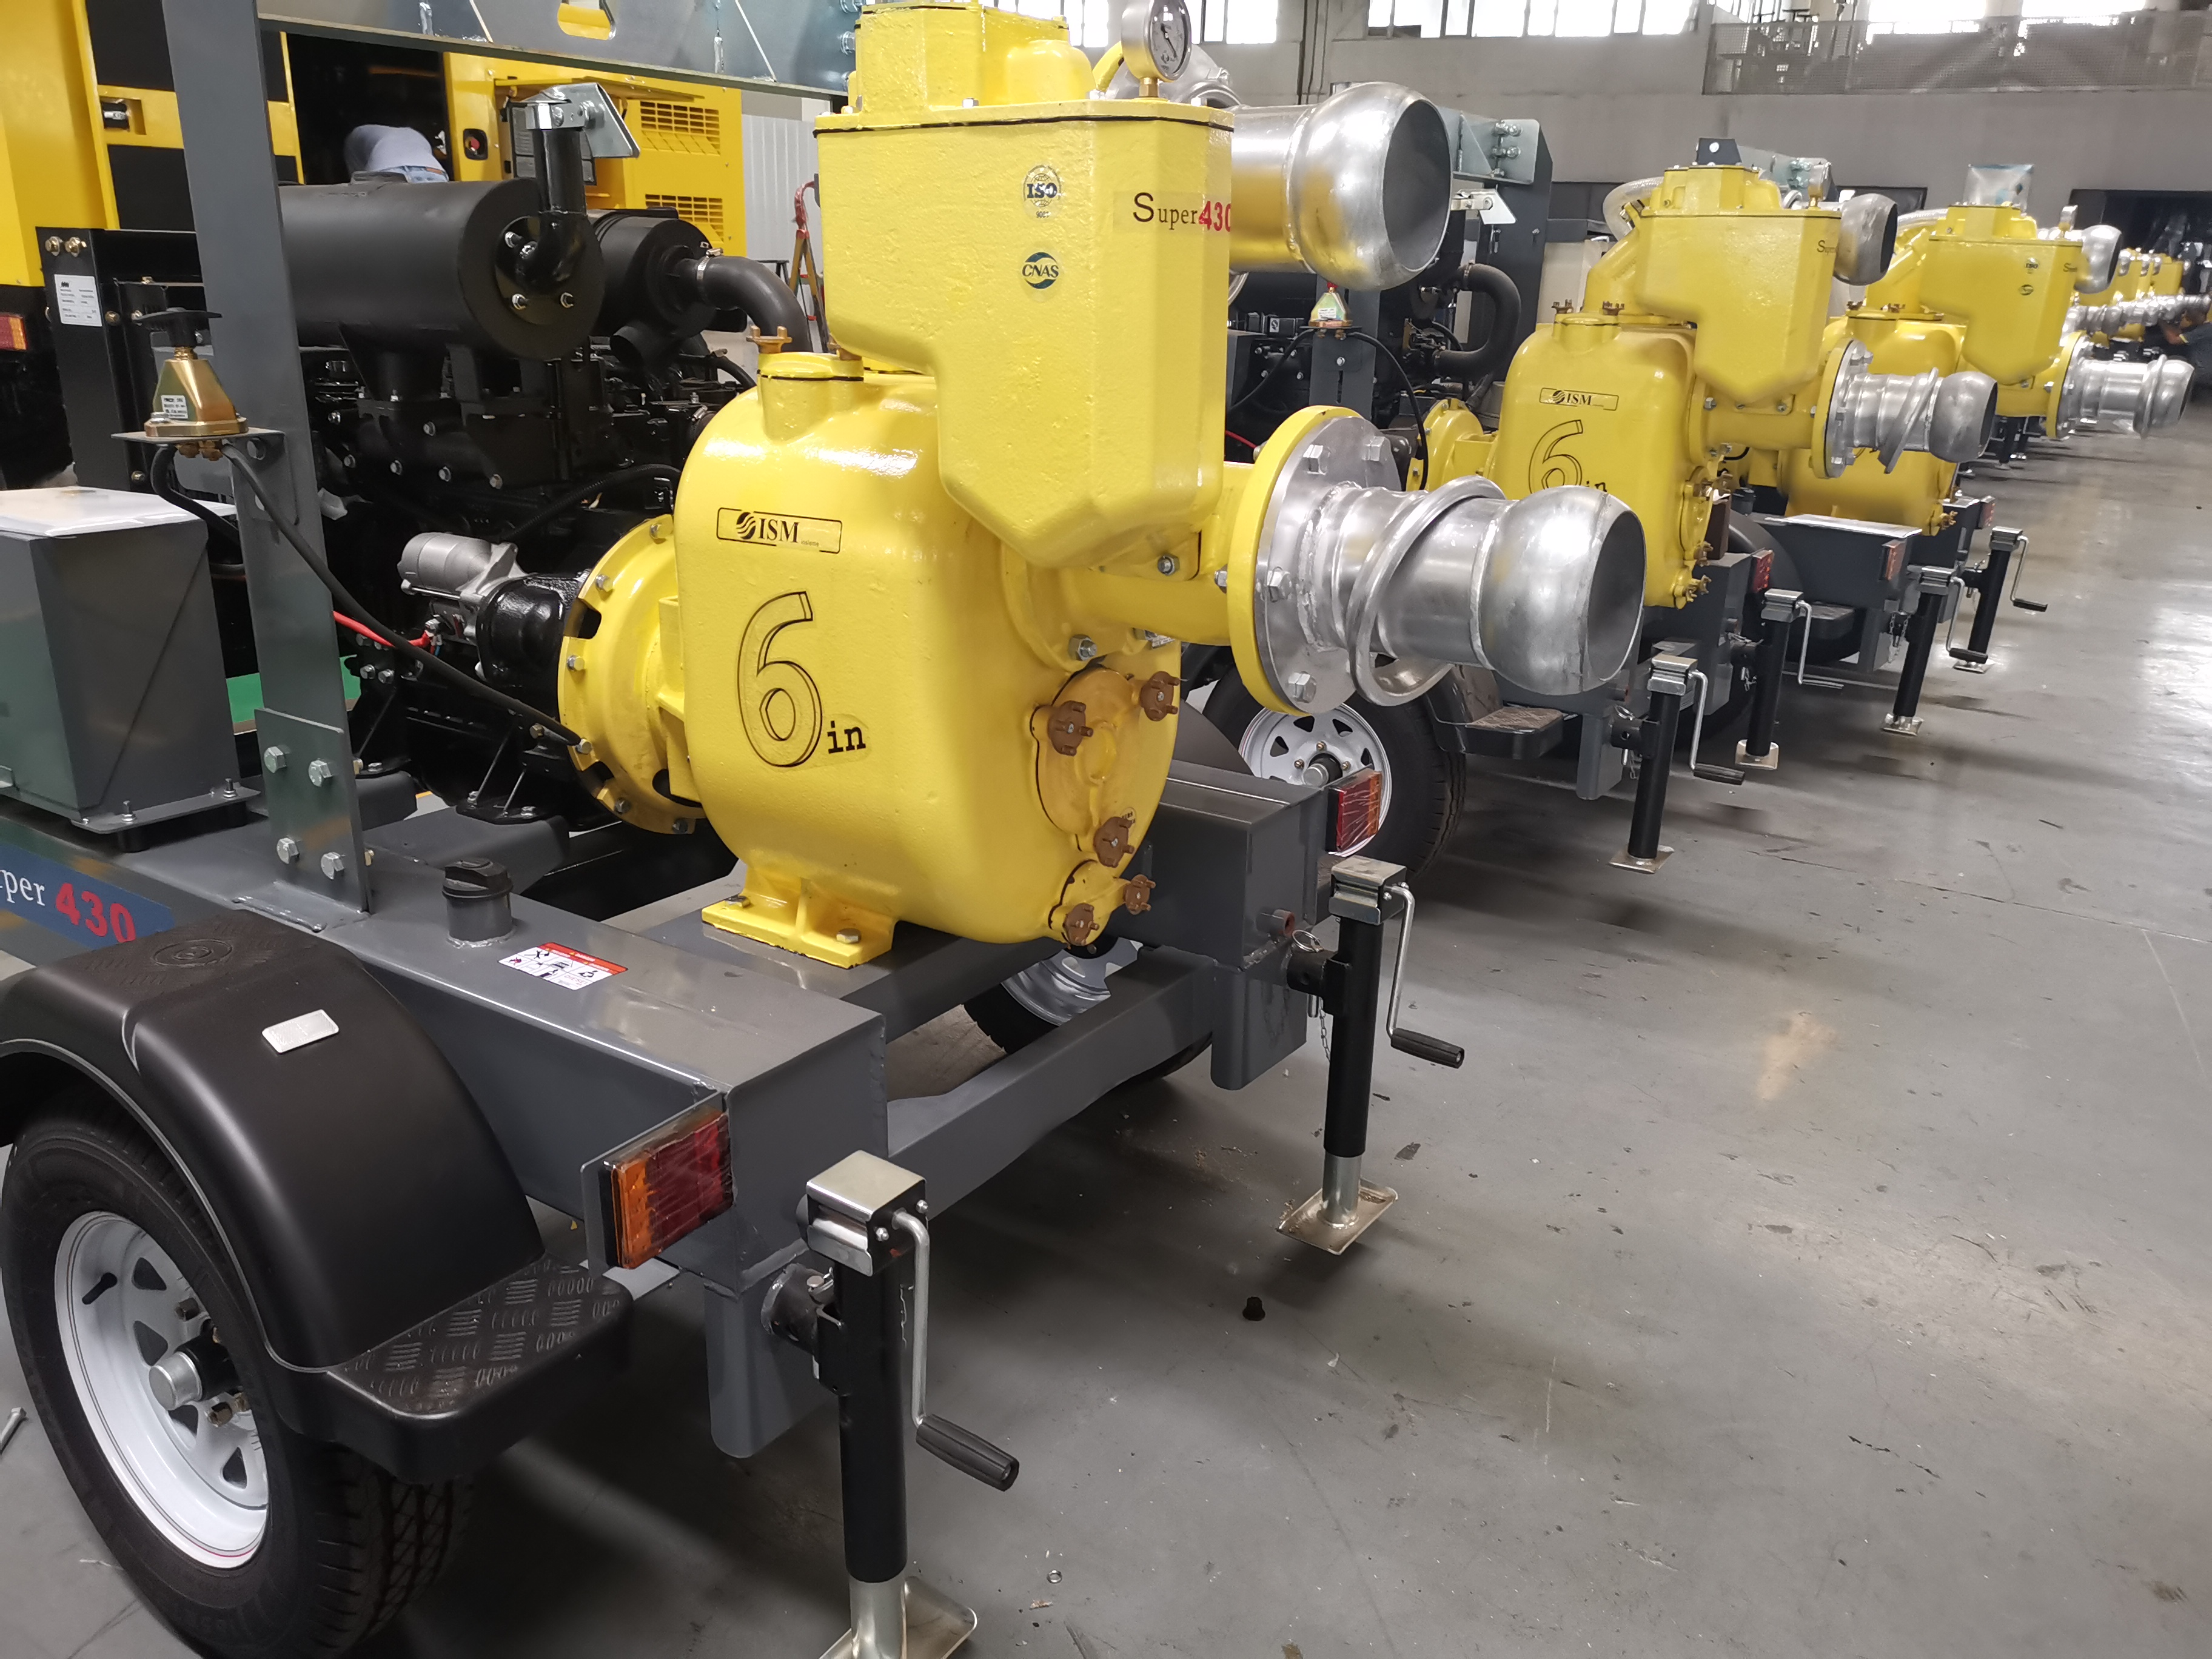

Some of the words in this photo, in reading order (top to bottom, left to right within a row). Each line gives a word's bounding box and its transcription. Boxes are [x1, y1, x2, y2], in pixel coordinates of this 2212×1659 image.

[1027, 183, 1057, 198] ISO
[1022, 264, 1059, 278] CNAS
[1566, 393, 1592, 405] ISM
[1528, 419, 1584, 494] 6
[757, 518, 800, 543] ISM
[737, 591, 823, 768] 6
[827, 720, 866, 754] in
[0, 870, 45, 906] per
[56, 883, 136, 943] 430
